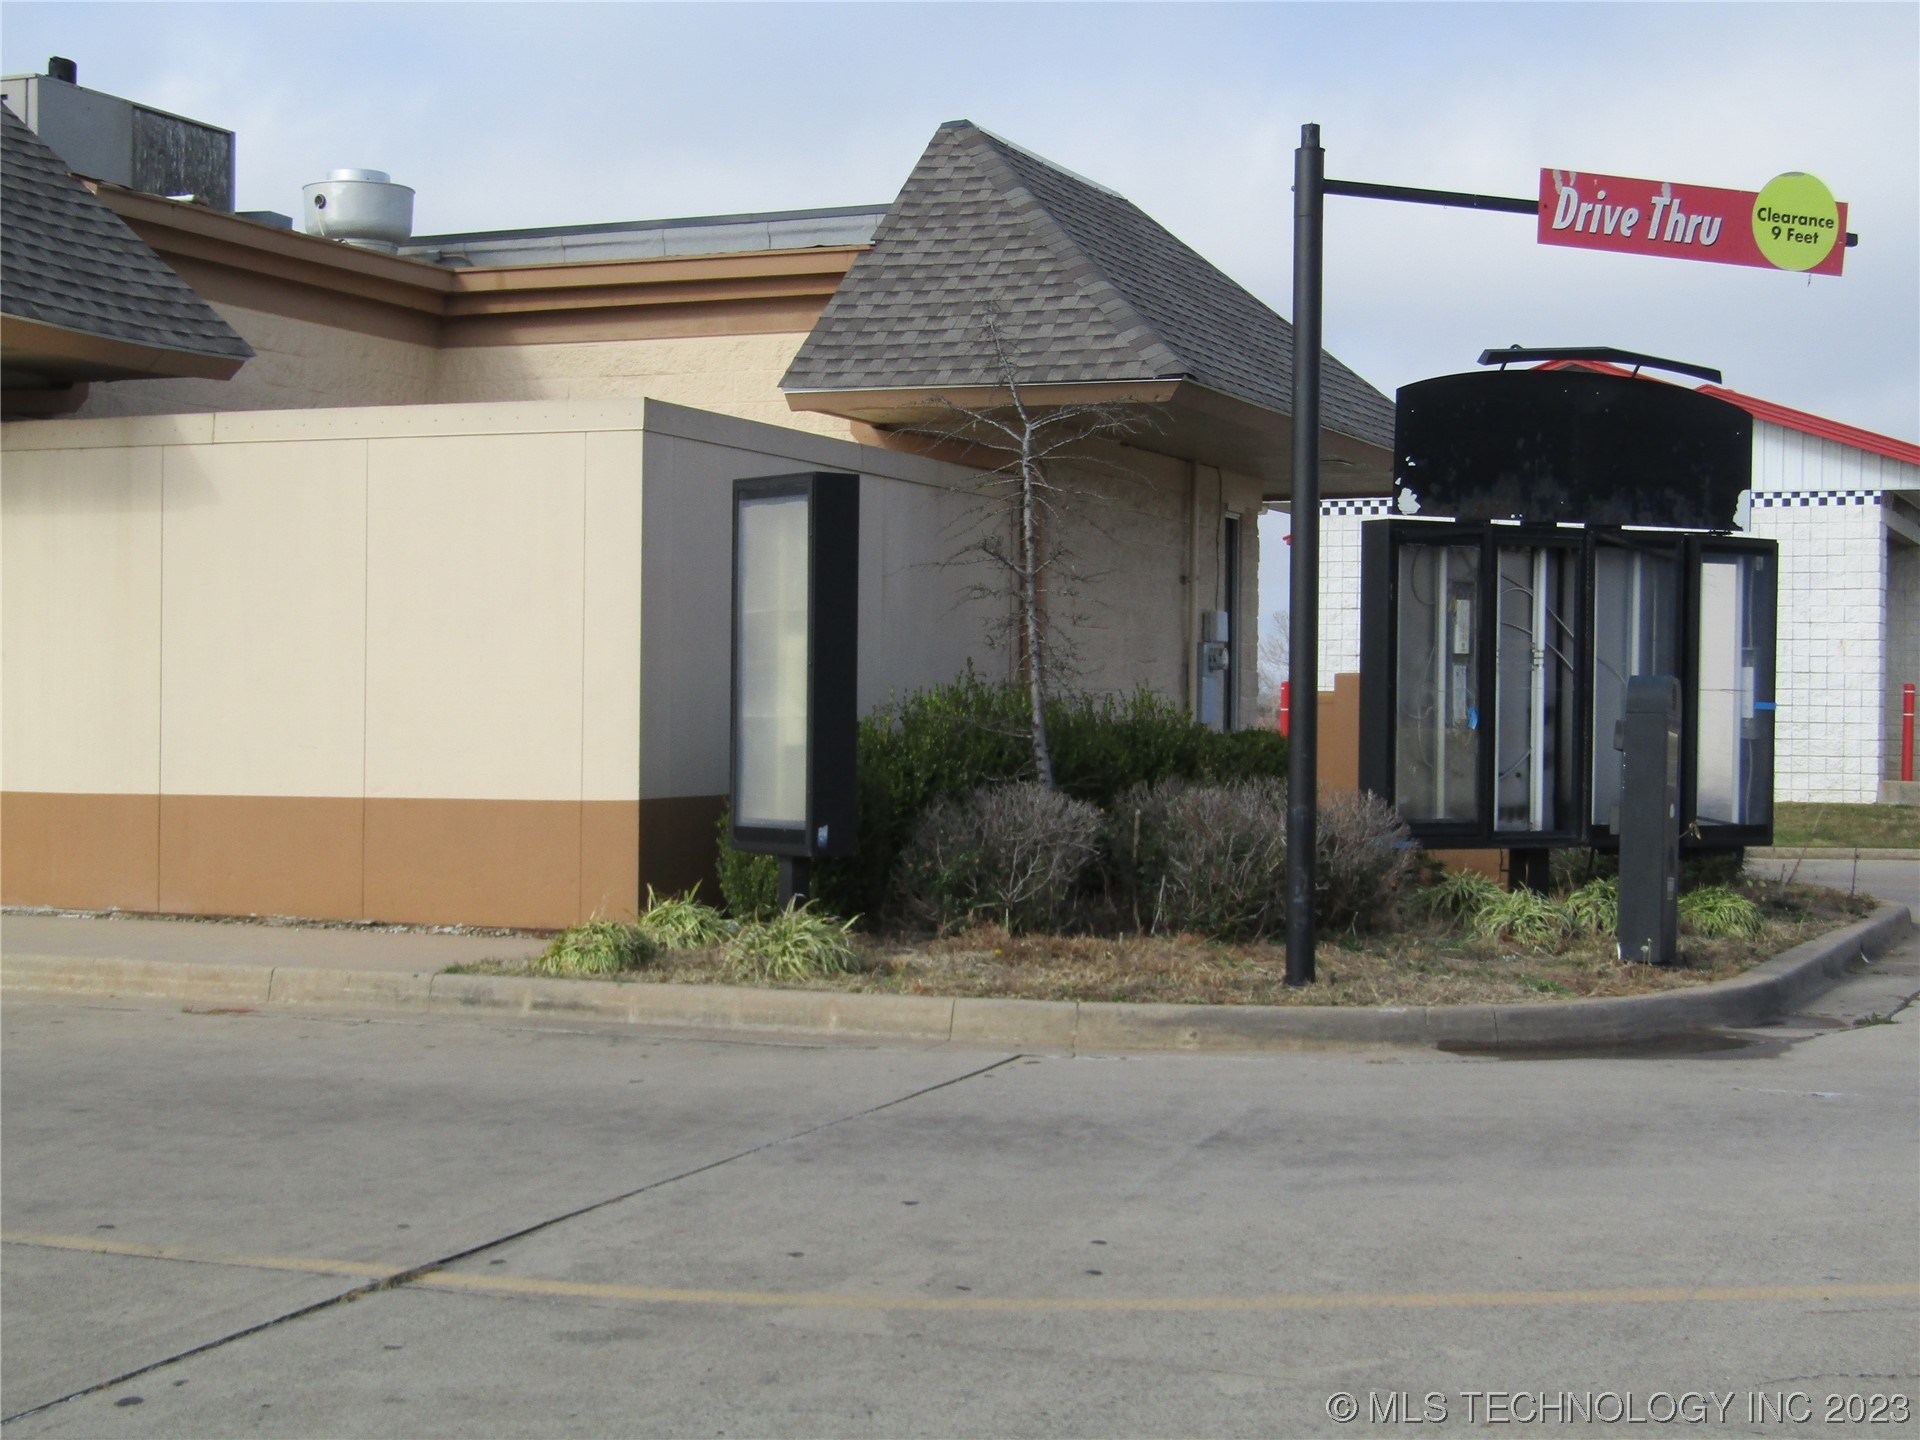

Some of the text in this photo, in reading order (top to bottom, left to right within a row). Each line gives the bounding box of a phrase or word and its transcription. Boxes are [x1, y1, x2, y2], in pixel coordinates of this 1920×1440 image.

[1551, 186, 1722, 246] Drive Thru
[1757, 207, 1834, 229] Clearance
[1771, 226, 1819, 245] 9 Feet
